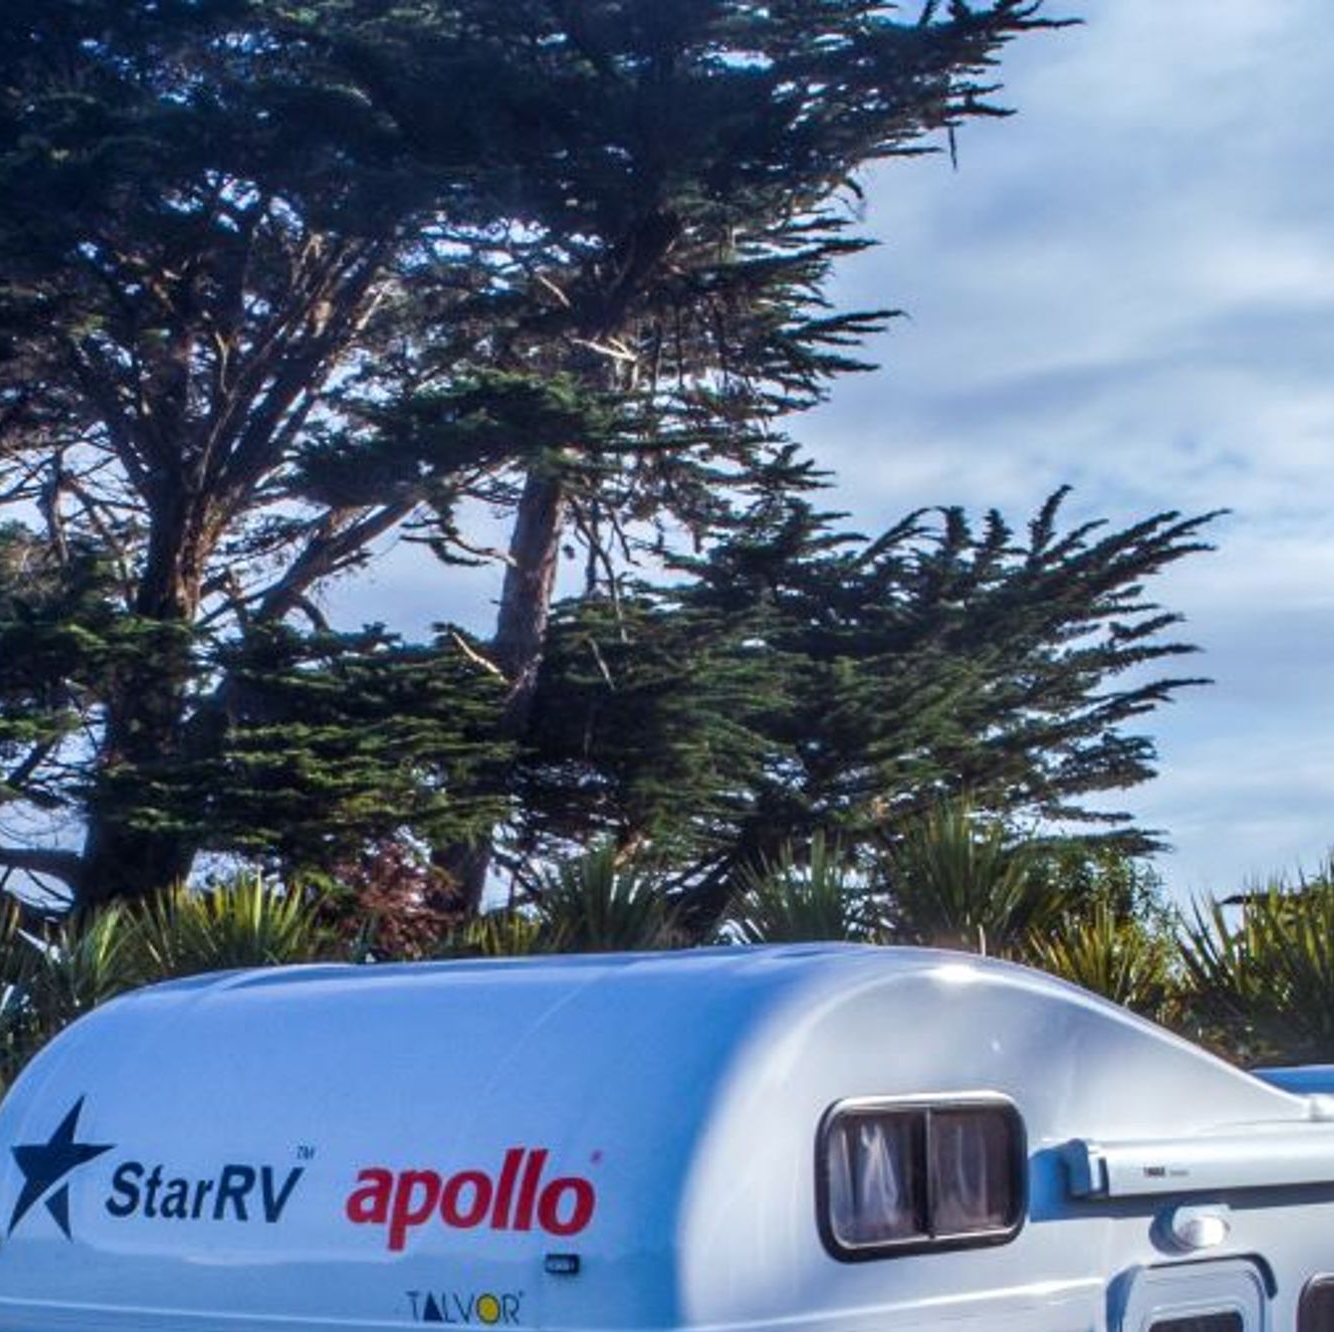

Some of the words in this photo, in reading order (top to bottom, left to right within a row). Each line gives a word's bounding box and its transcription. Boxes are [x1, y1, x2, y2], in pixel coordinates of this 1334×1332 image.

[105, 1161, 305, 1224] StarRV
[346, 1147, 596, 1252] apollo
[405, 1289, 521, 1325] TALVOR
